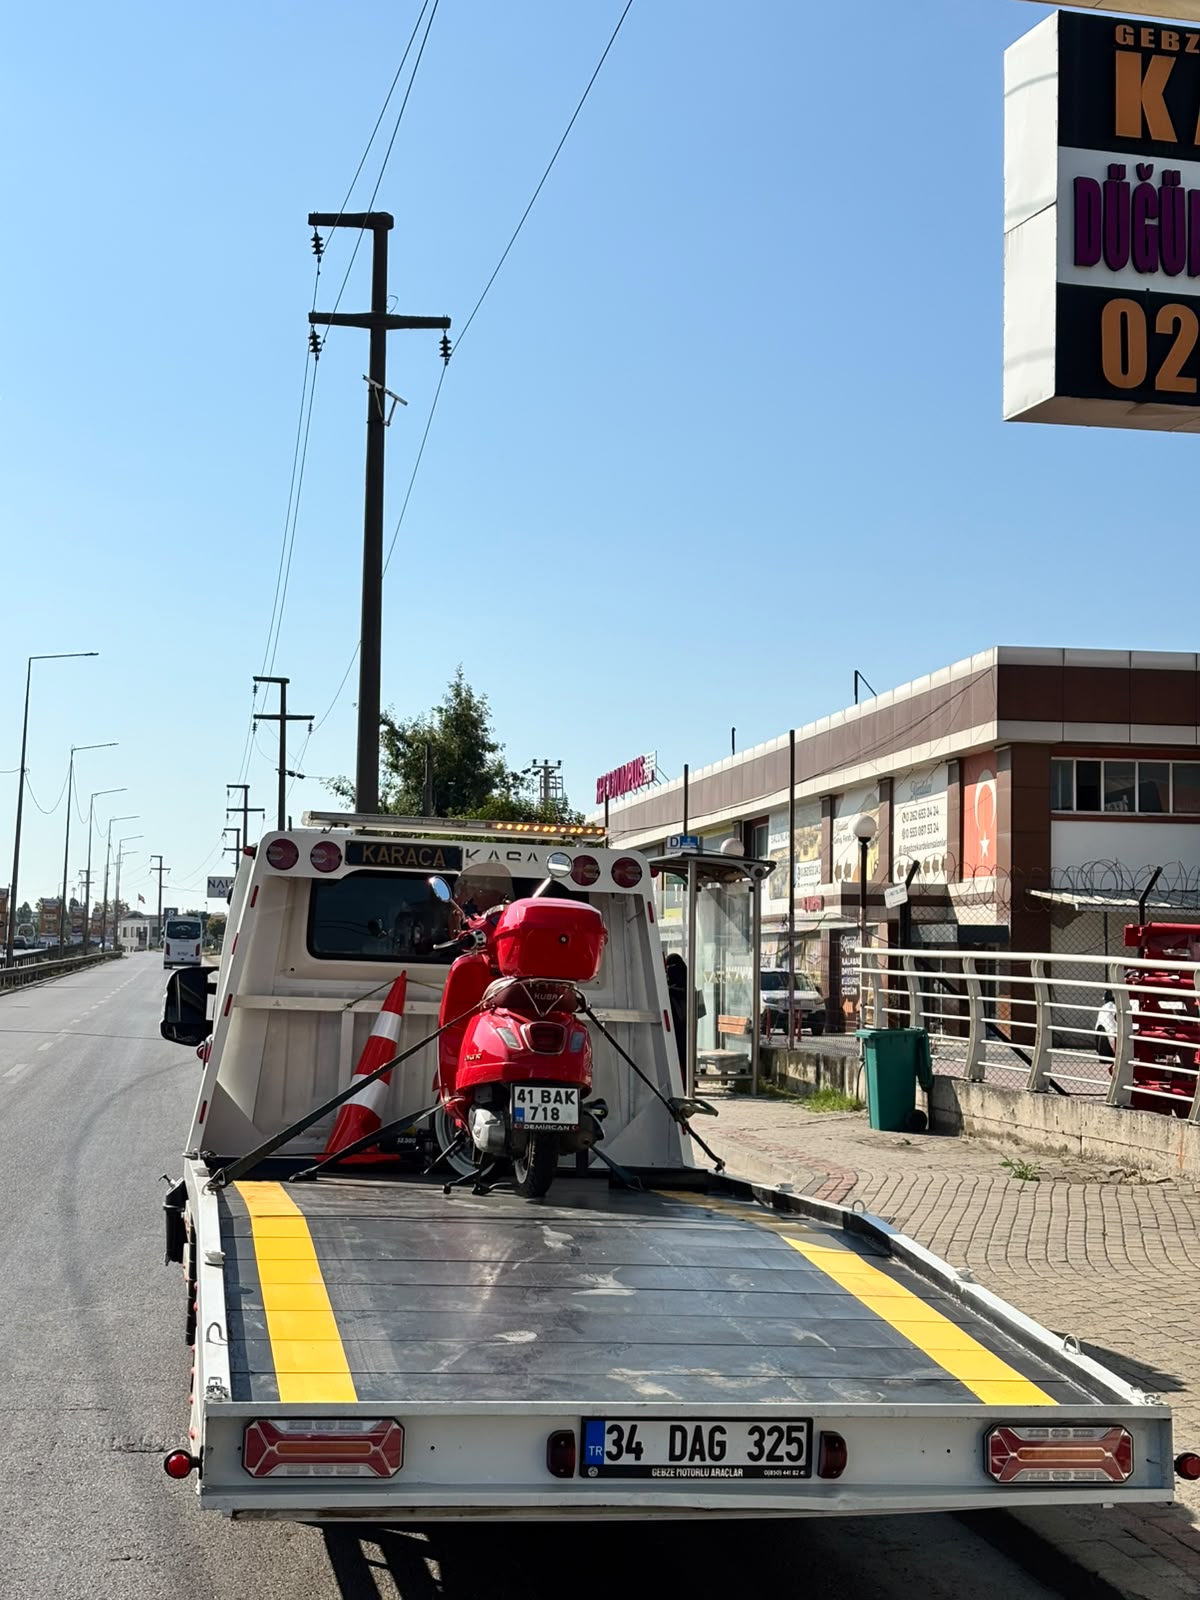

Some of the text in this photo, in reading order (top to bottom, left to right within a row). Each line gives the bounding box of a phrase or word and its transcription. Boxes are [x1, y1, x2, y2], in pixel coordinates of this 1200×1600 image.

[1115, 49, 1200, 146] K
[1101, 298, 1199, 393] 02
[670, 836, 679, 848] D
[362, 844, 446, 867] KARACA
[534, 992, 558, 1001] KUBA
[517, 1089, 576, 1105] 41 BAK
[529, 1106, 560, 1121] 718
[588, 1445, 603, 1456] TR
[605, 1424, 804, 1462] 34 DAG 325
[652, 1468, 744, 1478] GEBZE MOTORLU ARAÇLAR
